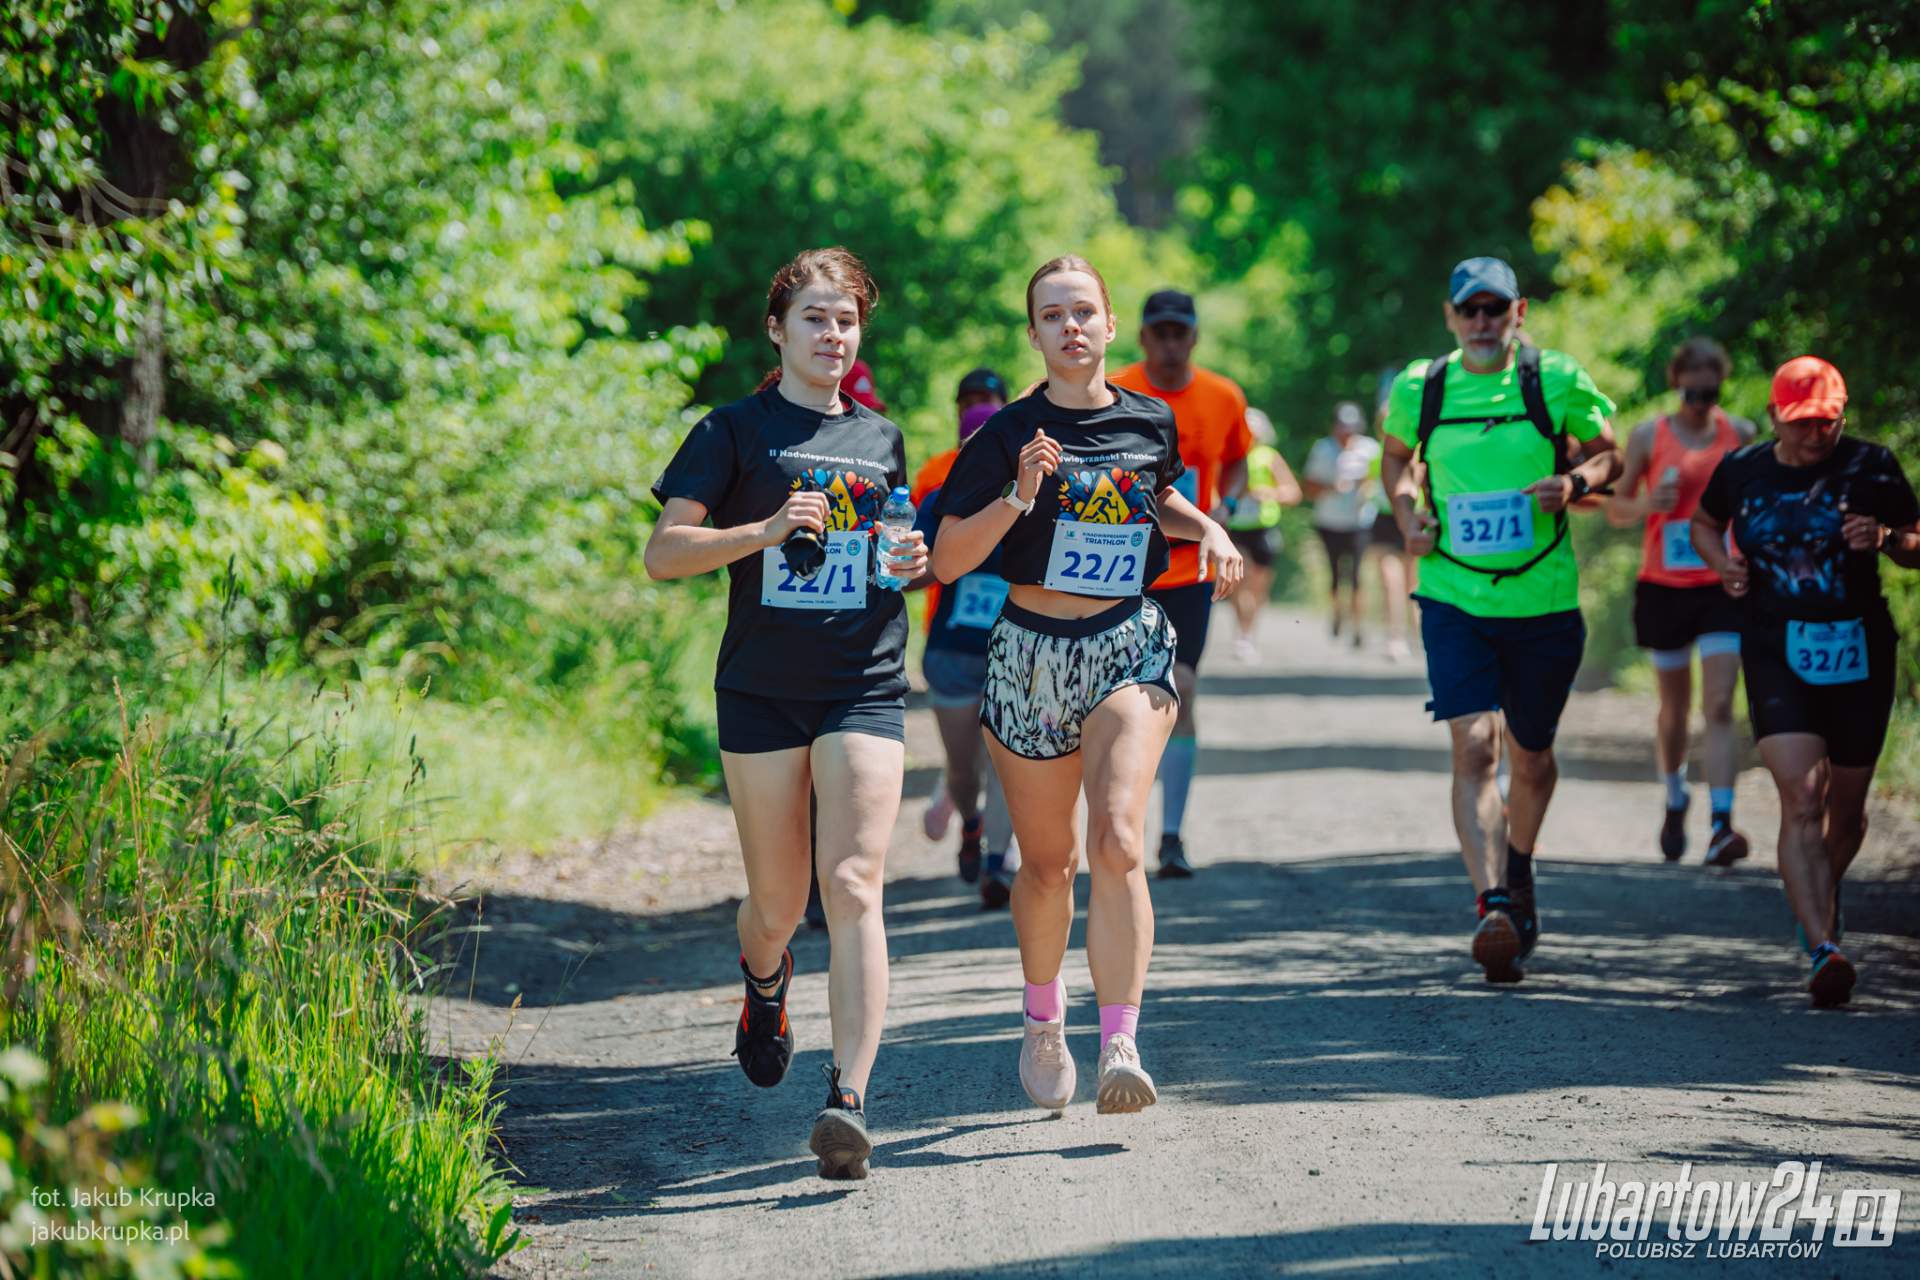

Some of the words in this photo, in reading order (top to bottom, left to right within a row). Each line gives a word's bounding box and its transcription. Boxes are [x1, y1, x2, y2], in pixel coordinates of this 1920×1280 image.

[1122, 452, 1157, 462] Triathlon
[1085, 537, 1126, 546] TRIATHLON
[1460, 514, 1523, 542] 32/1
[1060, 550, 1136, 583] 22/2
[1797, 645, 1861, 673] 32/2
